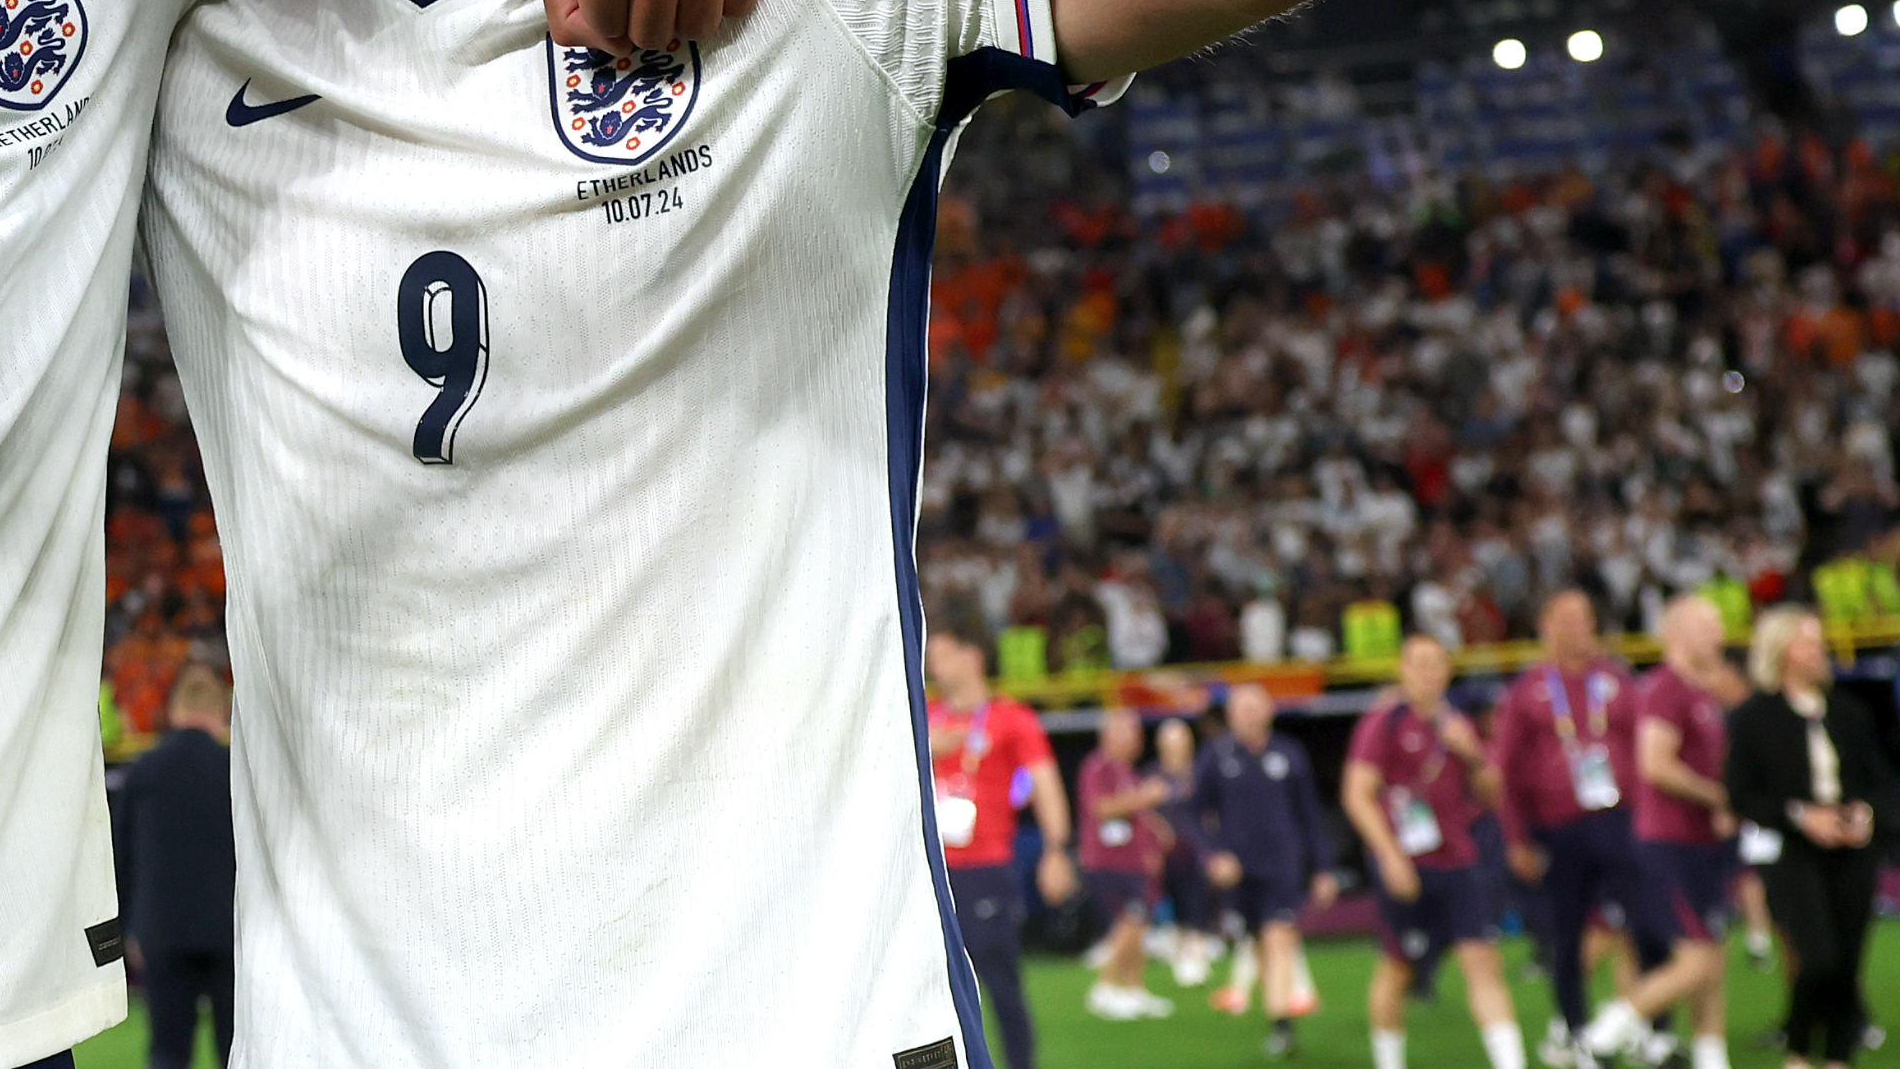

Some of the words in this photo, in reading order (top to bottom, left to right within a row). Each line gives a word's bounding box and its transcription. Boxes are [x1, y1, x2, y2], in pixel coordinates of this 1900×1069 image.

[576, 145, 713, 201] ETHERLANDS
[602, 187, 683, 224] 10.07.24
[397, 250, 490, 465] 9
